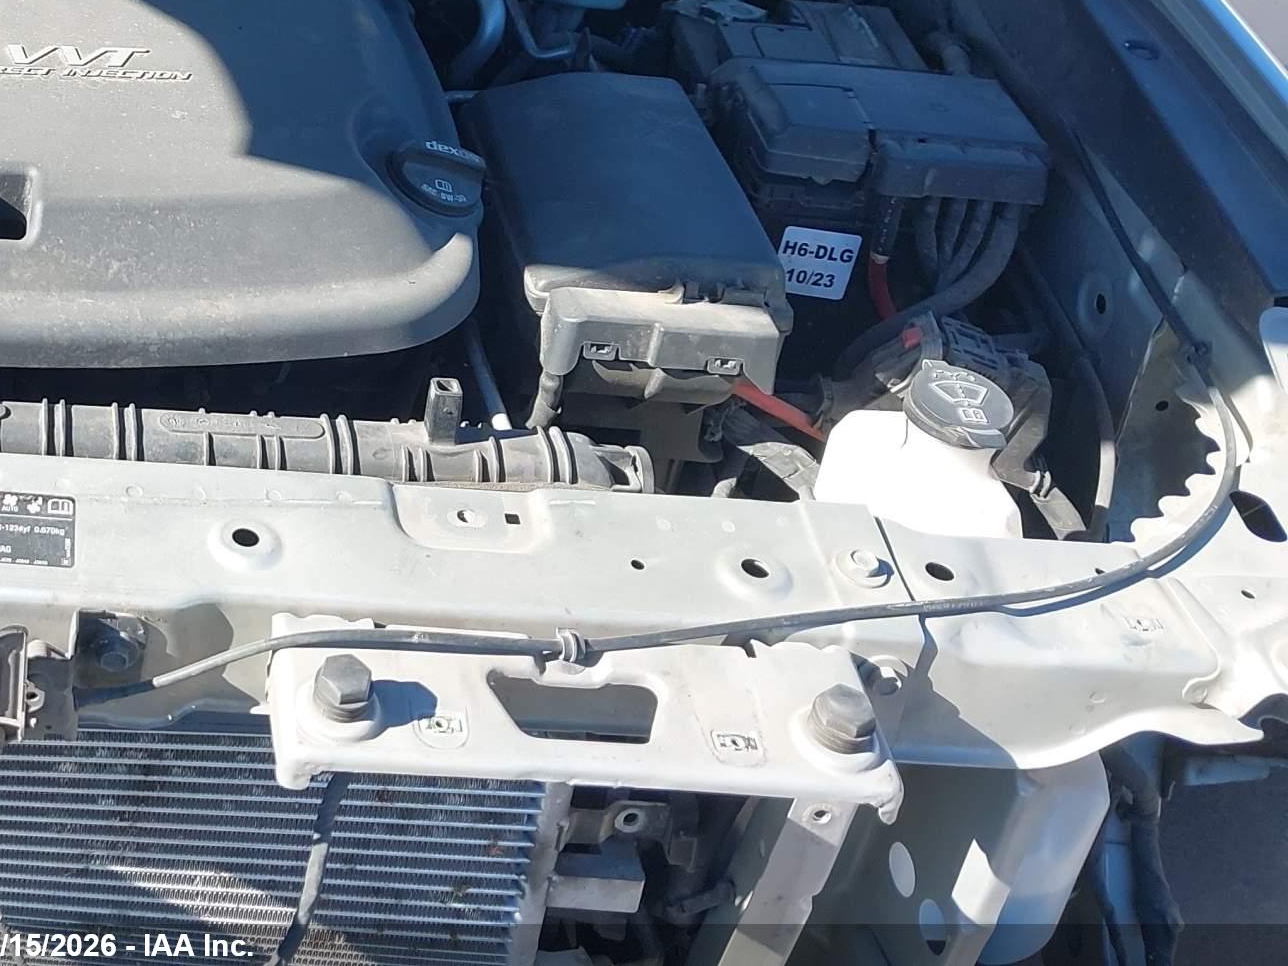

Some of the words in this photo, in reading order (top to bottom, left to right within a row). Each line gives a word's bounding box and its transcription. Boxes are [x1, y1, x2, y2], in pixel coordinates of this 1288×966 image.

[7, 44, 151, 68] VVT
[63, 68, 193, 81] INJECTION
[782, 240, 854, 263] H6-DLG
[786, 268, 835, 288] 10/23
